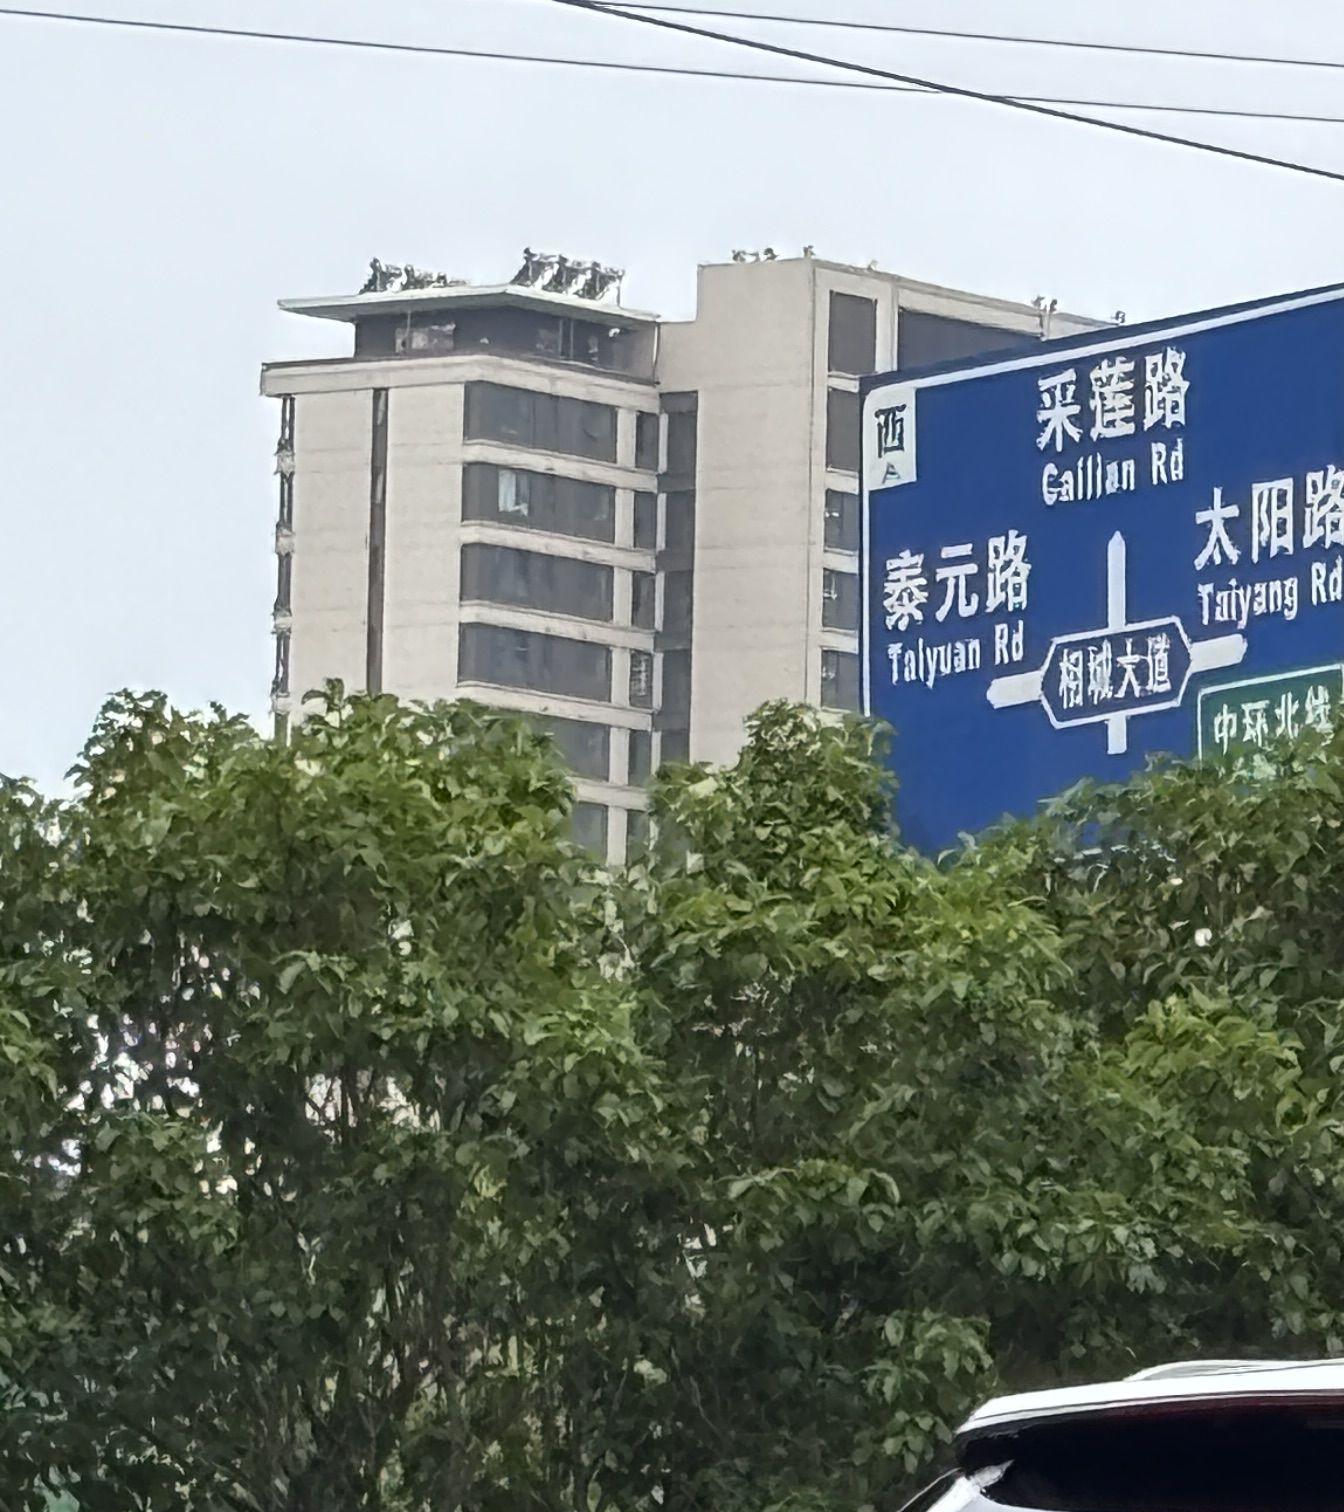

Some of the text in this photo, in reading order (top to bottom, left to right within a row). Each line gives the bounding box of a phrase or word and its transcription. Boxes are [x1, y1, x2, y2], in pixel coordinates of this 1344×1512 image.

[874, 404, 907, 458] 西
[1036, 346, 1190, 452] 采莲路
[1151, 438, 1183, 485] Rd
[883, 529, 1032, 631] 泰元路
[1198, 555, 1342, 629] Taiyang Rd
[888, 620, 1023, 689] Taiyuan Rd
[1059, 632, 1172, 709] 相城大道
